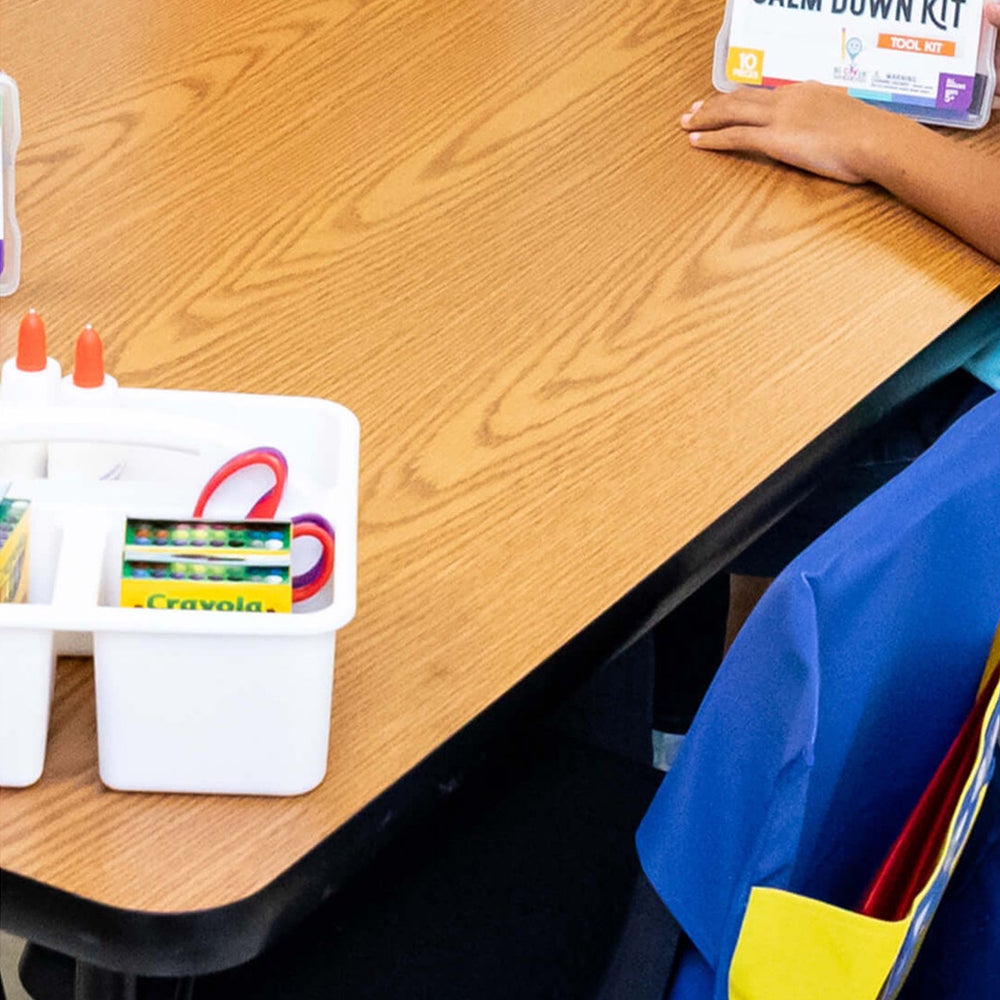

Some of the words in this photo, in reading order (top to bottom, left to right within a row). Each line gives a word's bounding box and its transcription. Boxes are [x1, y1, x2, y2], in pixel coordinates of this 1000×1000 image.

[890, 36, 921, 52] TOOL
[924, 41, 944, 54] KIT
[739, 53, 758, 70] 10
[147, 594, 262, 612] Crayola
